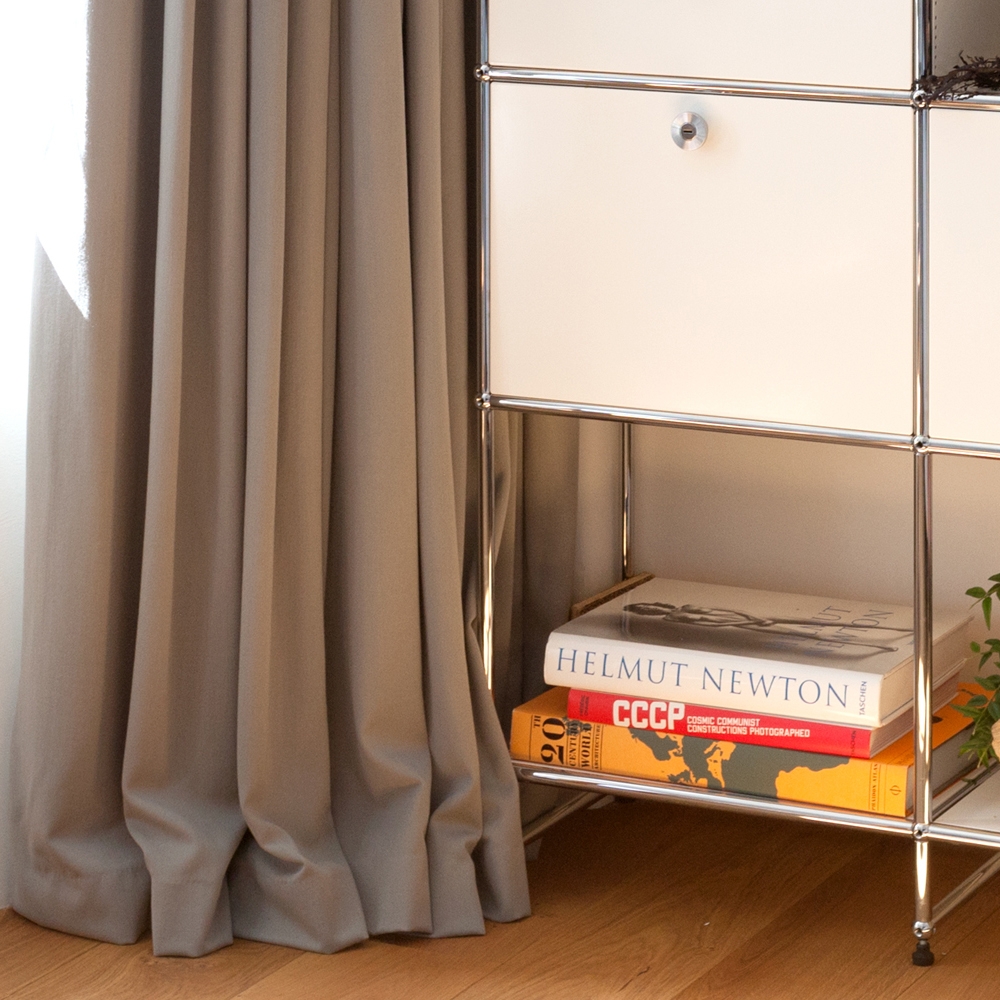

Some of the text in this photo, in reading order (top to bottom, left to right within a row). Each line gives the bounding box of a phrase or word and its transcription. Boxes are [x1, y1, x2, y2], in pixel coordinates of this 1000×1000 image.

[557, 648, 849, 709] HELMUT NEWTON
[859, 680, 868, 716] TASCHEN
[612, 700, 686, 730] CCCP
[687, 716, 760, 727] COSMIC COMMUNIST
[687, 725, 810, 738] CONSTRUCTIONS PHOTOGRAPHED
[541, 717, 566, 765] 20
